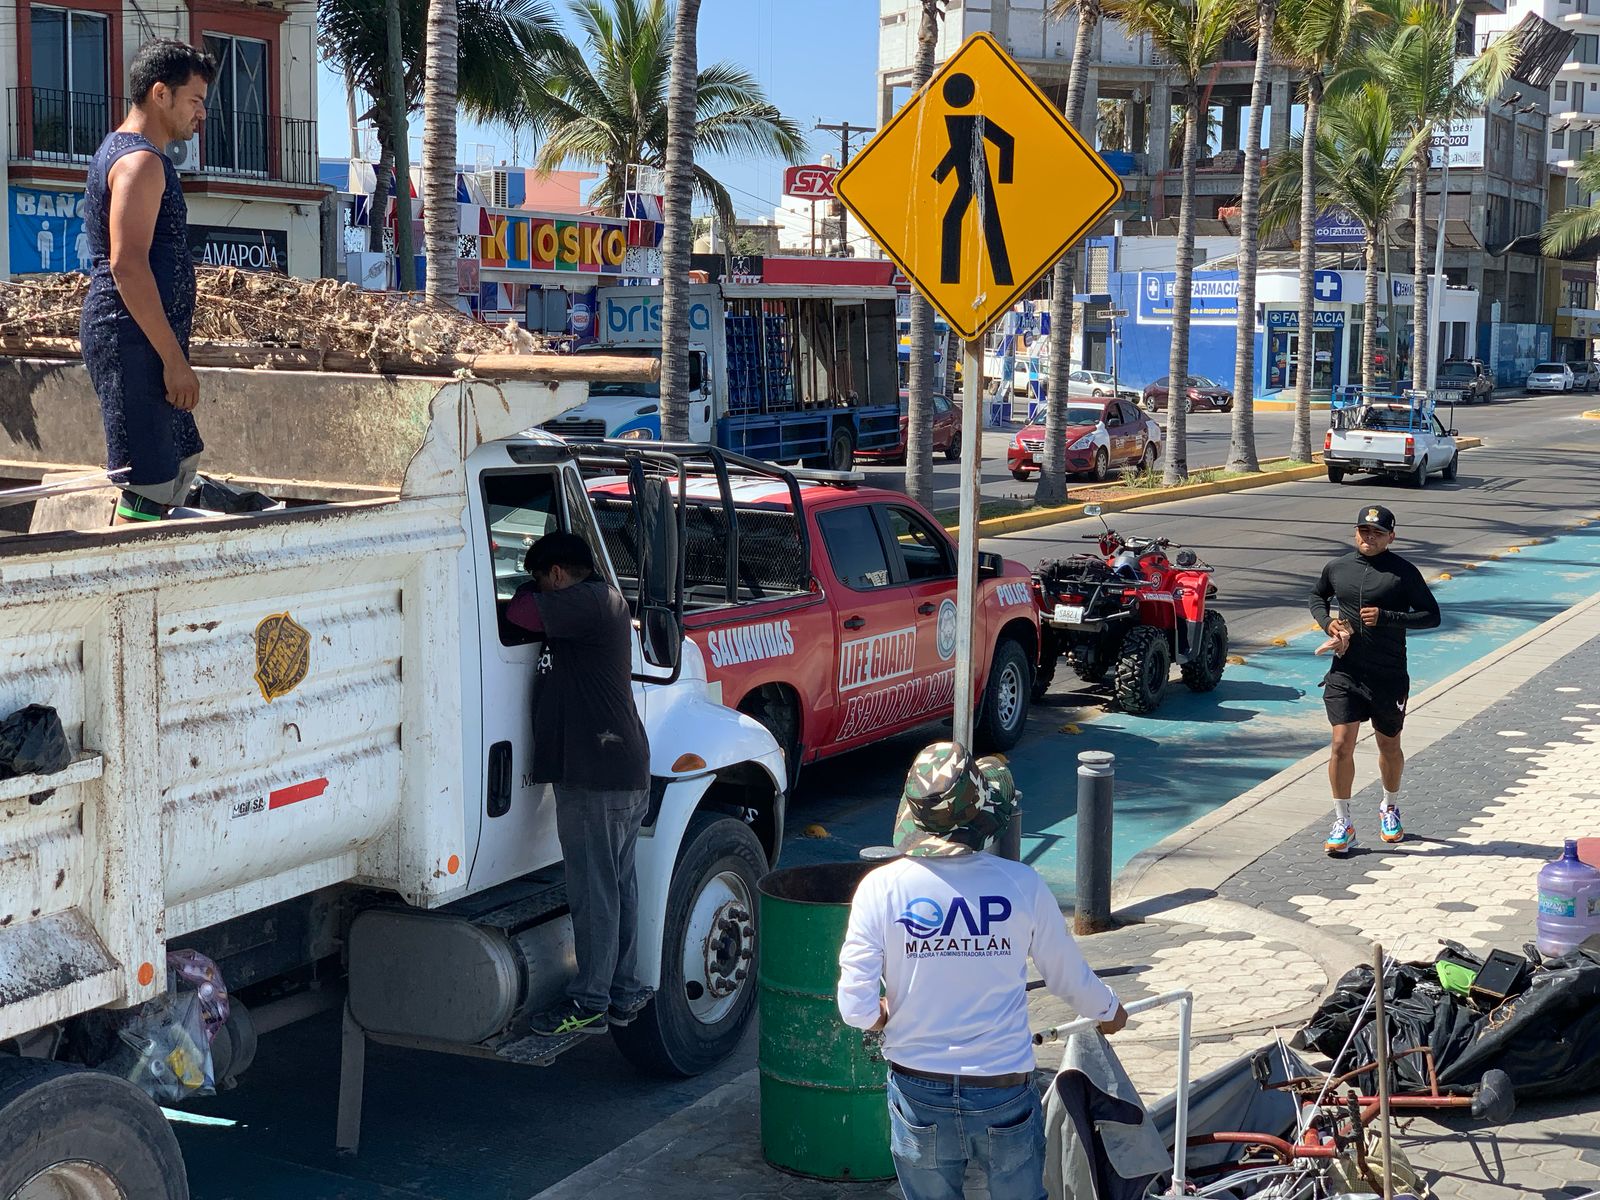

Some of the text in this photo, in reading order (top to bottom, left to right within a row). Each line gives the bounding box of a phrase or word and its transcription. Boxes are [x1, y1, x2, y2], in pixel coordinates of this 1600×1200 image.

[16, 193, 85, 218] BAÑ
[202, 242, 278, 268] AMAPOLA
[486, 219, 626, 266] KIOSKO
[1282, 312, 1344, 323] FAACIA
[997, 583, 1032, 607] POLICE
[707, 619, 795, 669] SALVAVIDAS
[841, 628, 916, 688] LIFE GUARD
[906, 935, 1011, 954] MAZATLÁN
